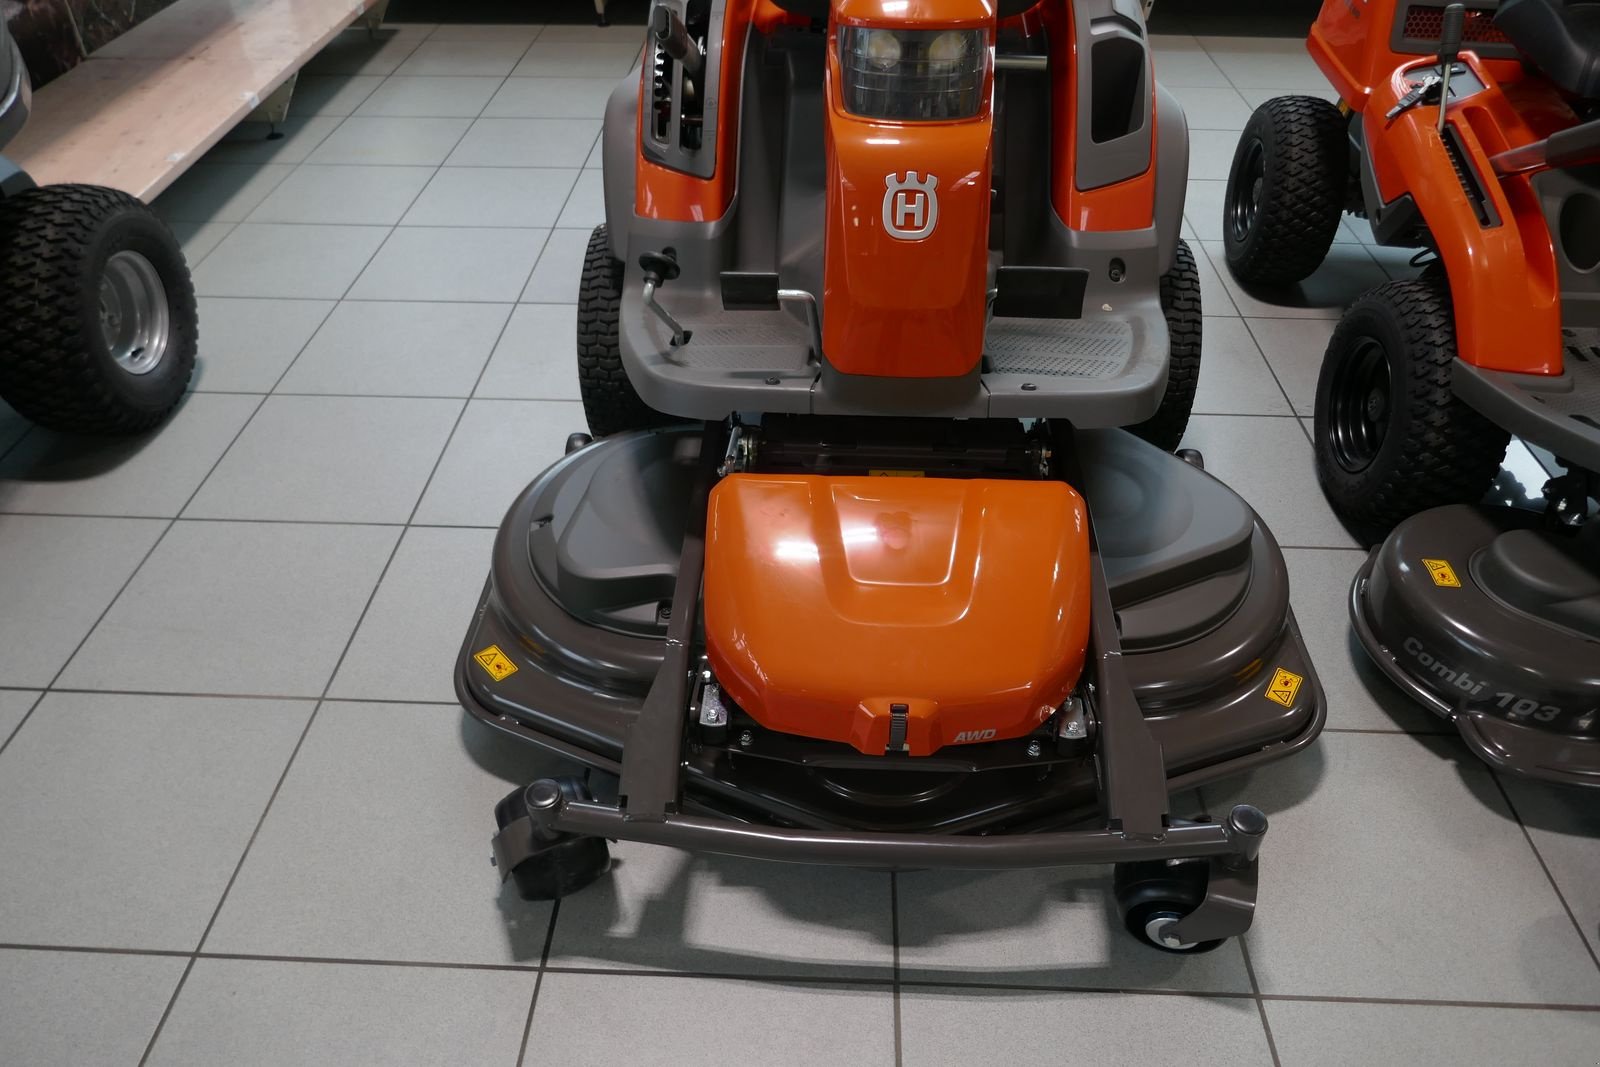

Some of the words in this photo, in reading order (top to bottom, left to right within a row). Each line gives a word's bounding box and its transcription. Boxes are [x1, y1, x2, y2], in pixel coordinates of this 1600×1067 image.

[1403, 637, 1489, 695] Combi
[1496, 692, 1560, 721] 103
[953, 729, 996, 742] AWD
